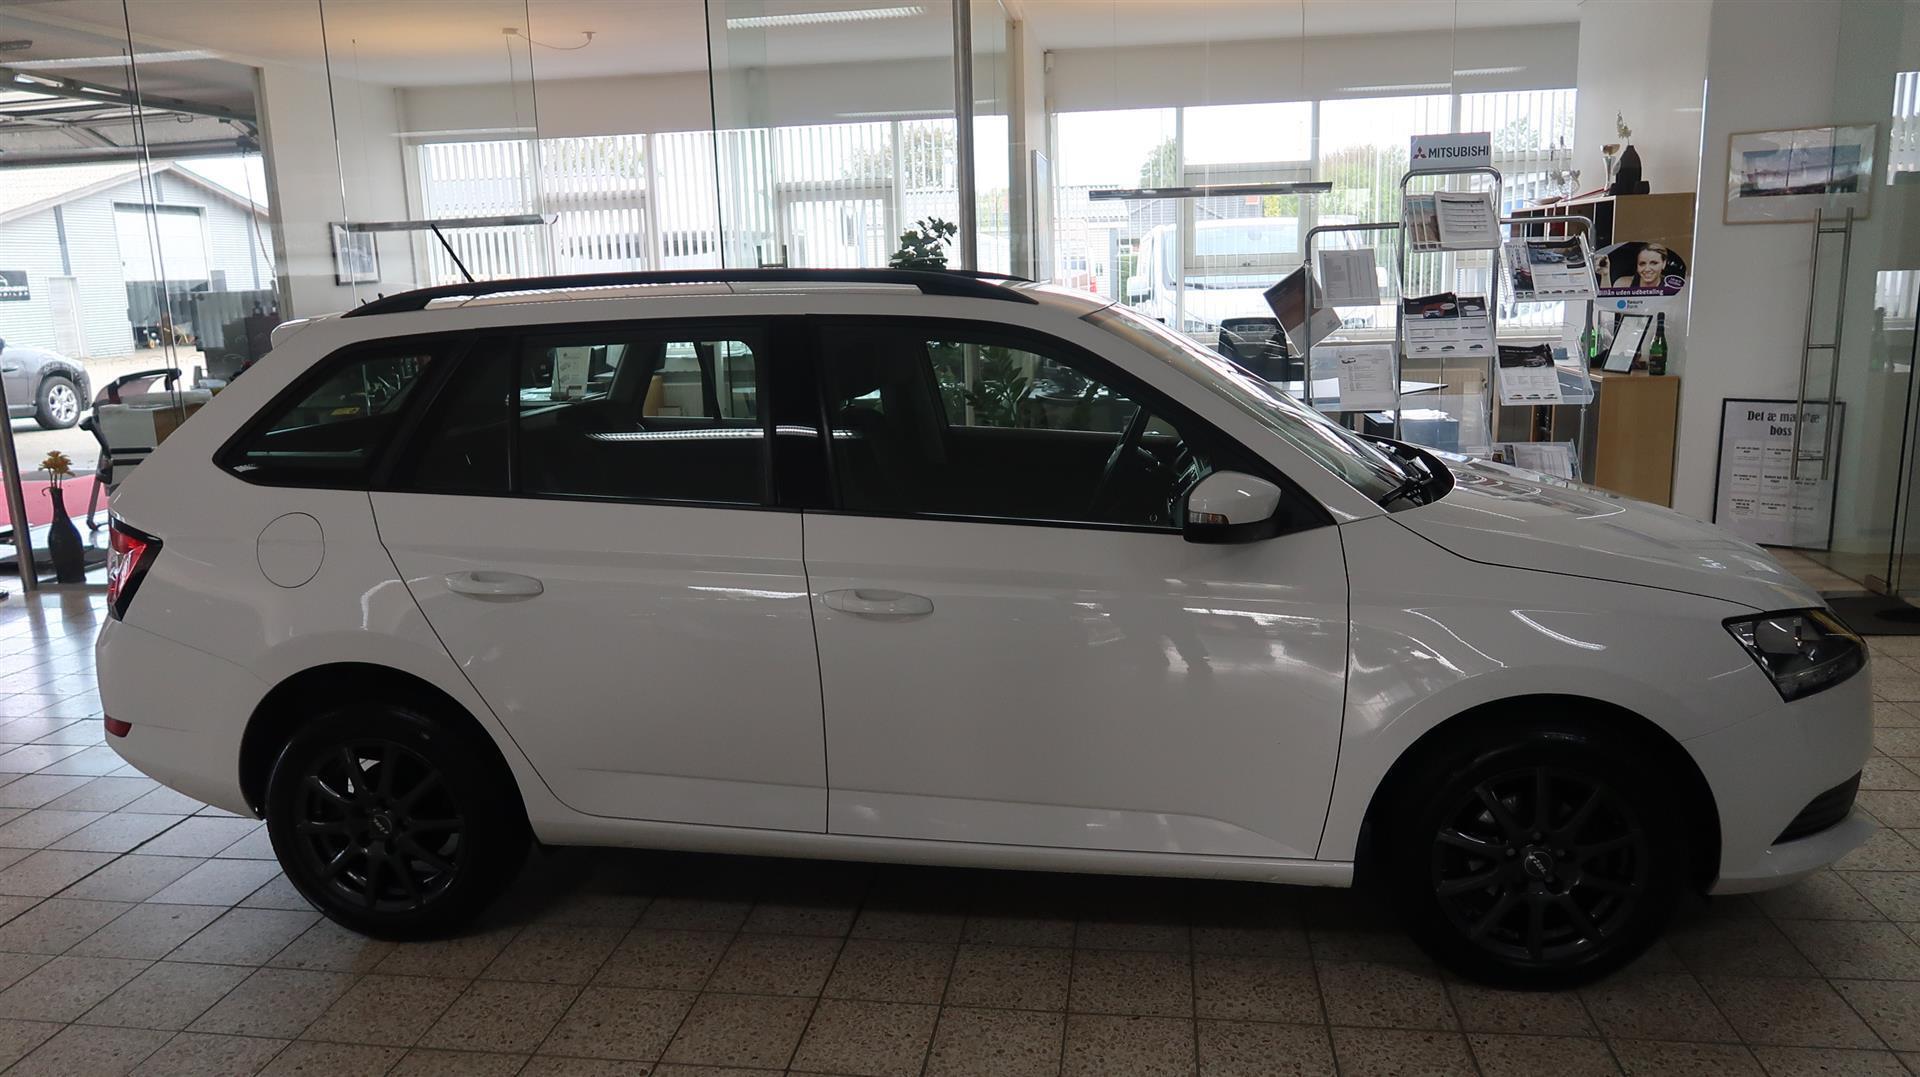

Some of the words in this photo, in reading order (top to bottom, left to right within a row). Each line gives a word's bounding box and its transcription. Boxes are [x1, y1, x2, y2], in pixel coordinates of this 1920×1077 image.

[1428, 145, 1489, 158] MITSUBISHI
[1747, 410, 1764, 421] Det
[1770, 425, 1792, 436] boss
